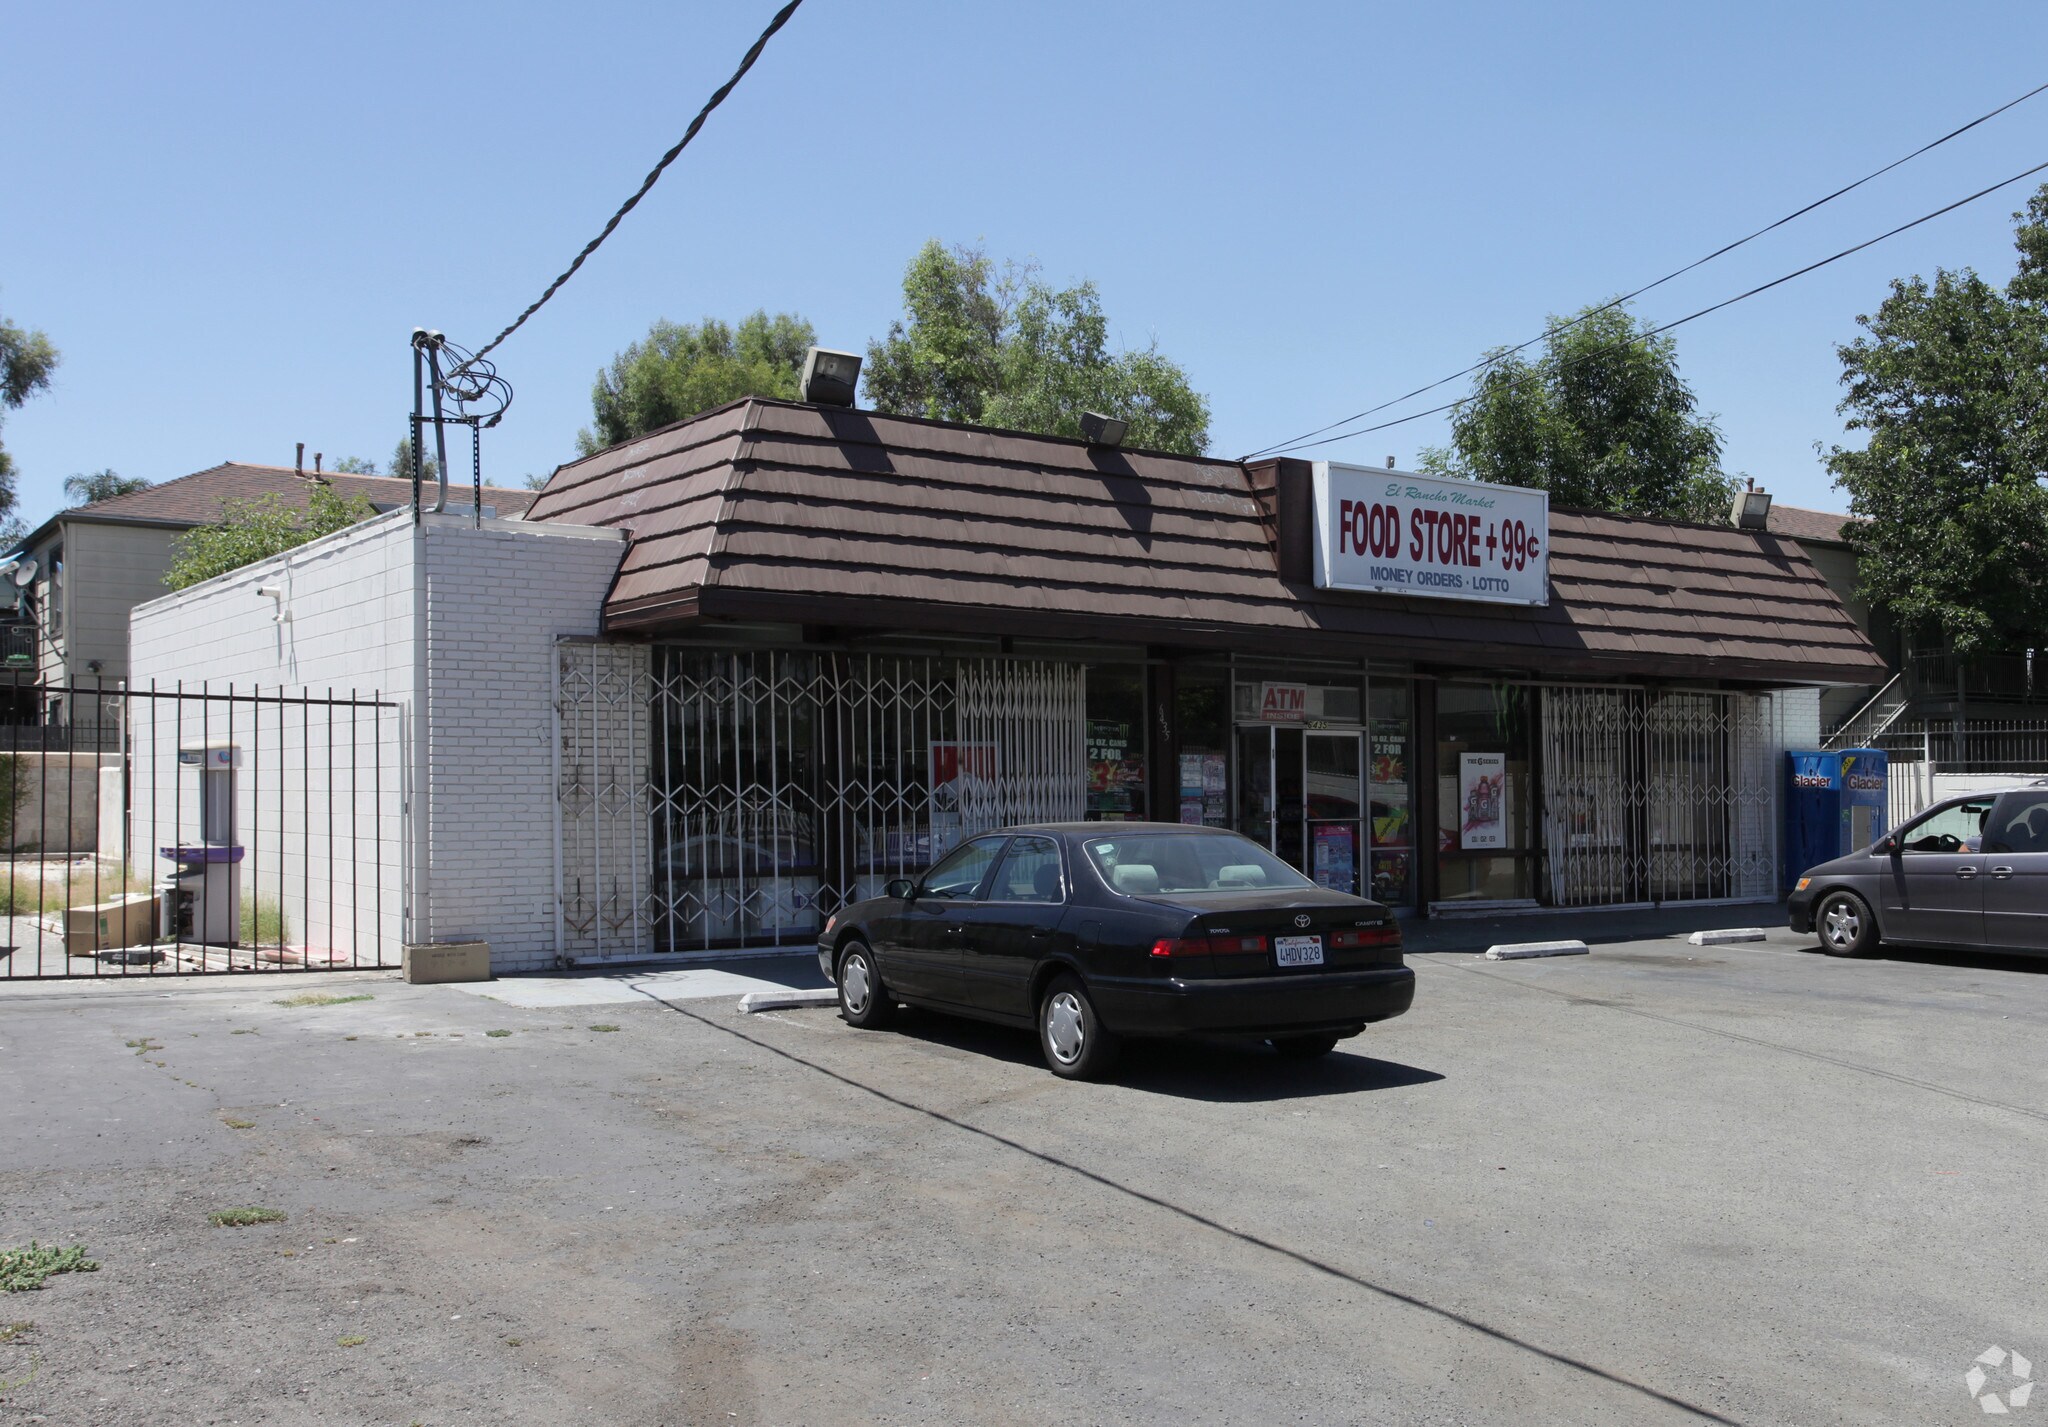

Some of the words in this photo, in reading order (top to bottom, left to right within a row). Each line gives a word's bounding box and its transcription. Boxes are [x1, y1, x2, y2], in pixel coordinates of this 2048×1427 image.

[1385, 483, 1402, 497] El
[1404, 486, 1447, 502] Rancho
[1450, 491, 1495, 509] Market
[1340, 499, 1400, 559] FOOD
[1410, 508, 1481, 567] STORE
[1370, 566, 1412, 583] MONEY
[1417, 572, 1463, 589] ORDERS
[1472, 576, 1509, 592] LOTTO
[1264, 687, 1305, 710] ATM
[1266, 712, 1301, 720] INSIDE
[1308, 721, 1329, 729] 6435
[1109, 739, 1128, 748] CANS
[1374, 743, 1381, 754] 2
[1383, 743, 1402, 755] FOR
[1089, 748, 1098, 760] 2
[1100, 748, 1122, 760] FOR
[1792, 775, 1831, 787] Glacier
[1848, 775, 1883, 790] Glacier
[1280, 946, 1321, 962] 4HDV328
